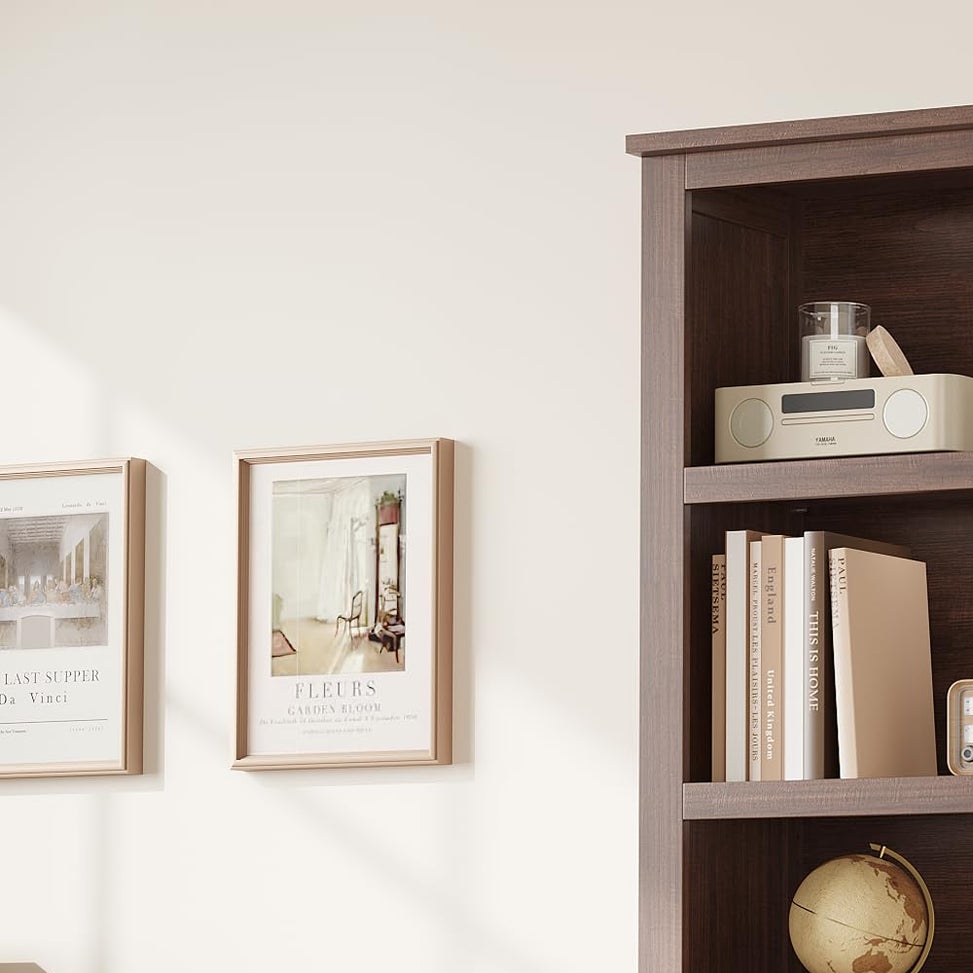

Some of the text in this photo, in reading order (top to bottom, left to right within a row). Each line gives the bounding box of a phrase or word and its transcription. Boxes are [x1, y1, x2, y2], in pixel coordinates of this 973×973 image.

[837, 557, 847, 595] PAUL
[764, 567, 777, 625] England
[808, 611, 819, 712] THIS IS HOME
[4, 669, 100, 686] LAST SUPPER
[295, 680, 377, 699] FLEURS
[29, 690, 68, 704] Vinci
[287, 703, 382, 716] GARDEN BLOOM
[765, 669, 775, 760] United Kingdom
